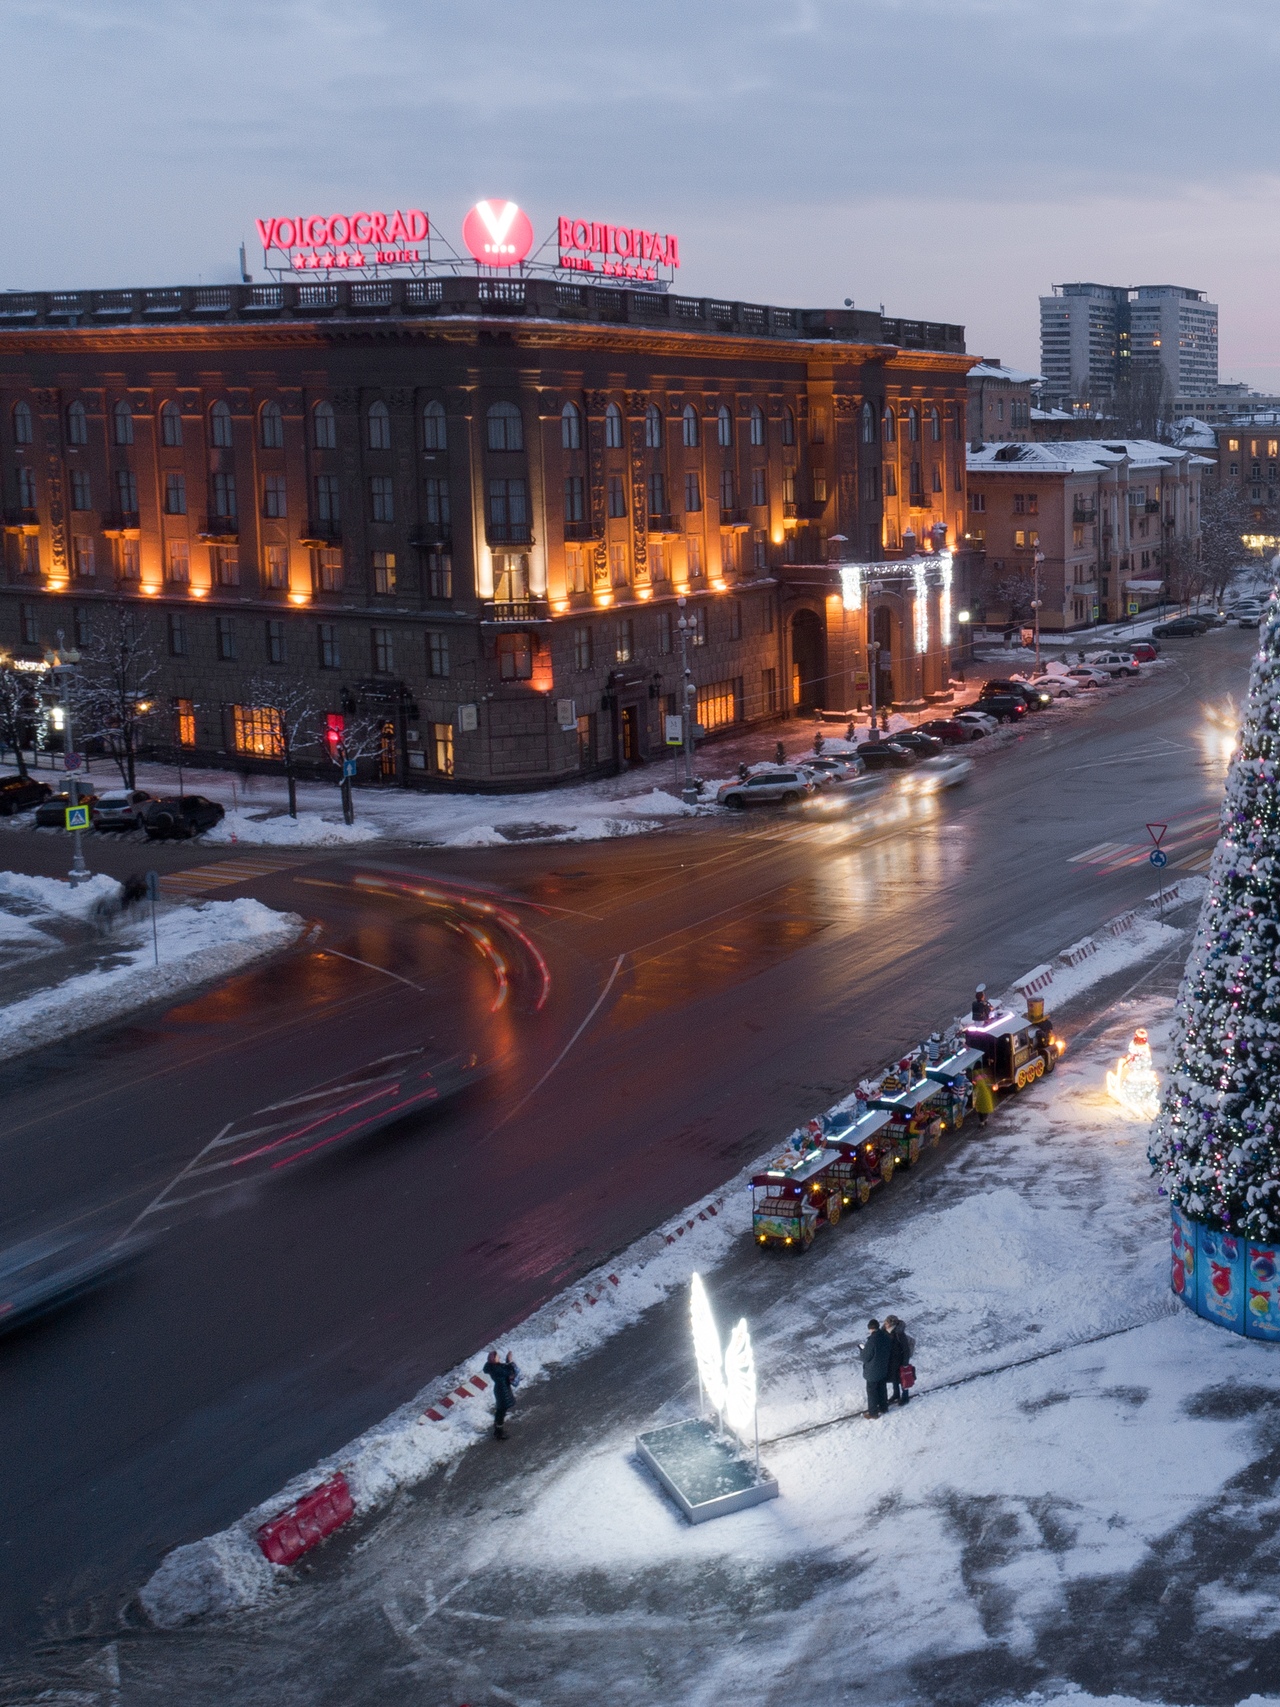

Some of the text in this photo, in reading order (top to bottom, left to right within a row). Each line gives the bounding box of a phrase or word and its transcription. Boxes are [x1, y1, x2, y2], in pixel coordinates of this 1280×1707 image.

[255, 208, 430, 250] VOLGOGRAD
[558, 214, 680, 269] ВОЛГОГРАД
[374, 250, 420, 264] HOTEL
[560, 255, 595, 273] ОТЕЛЬ
